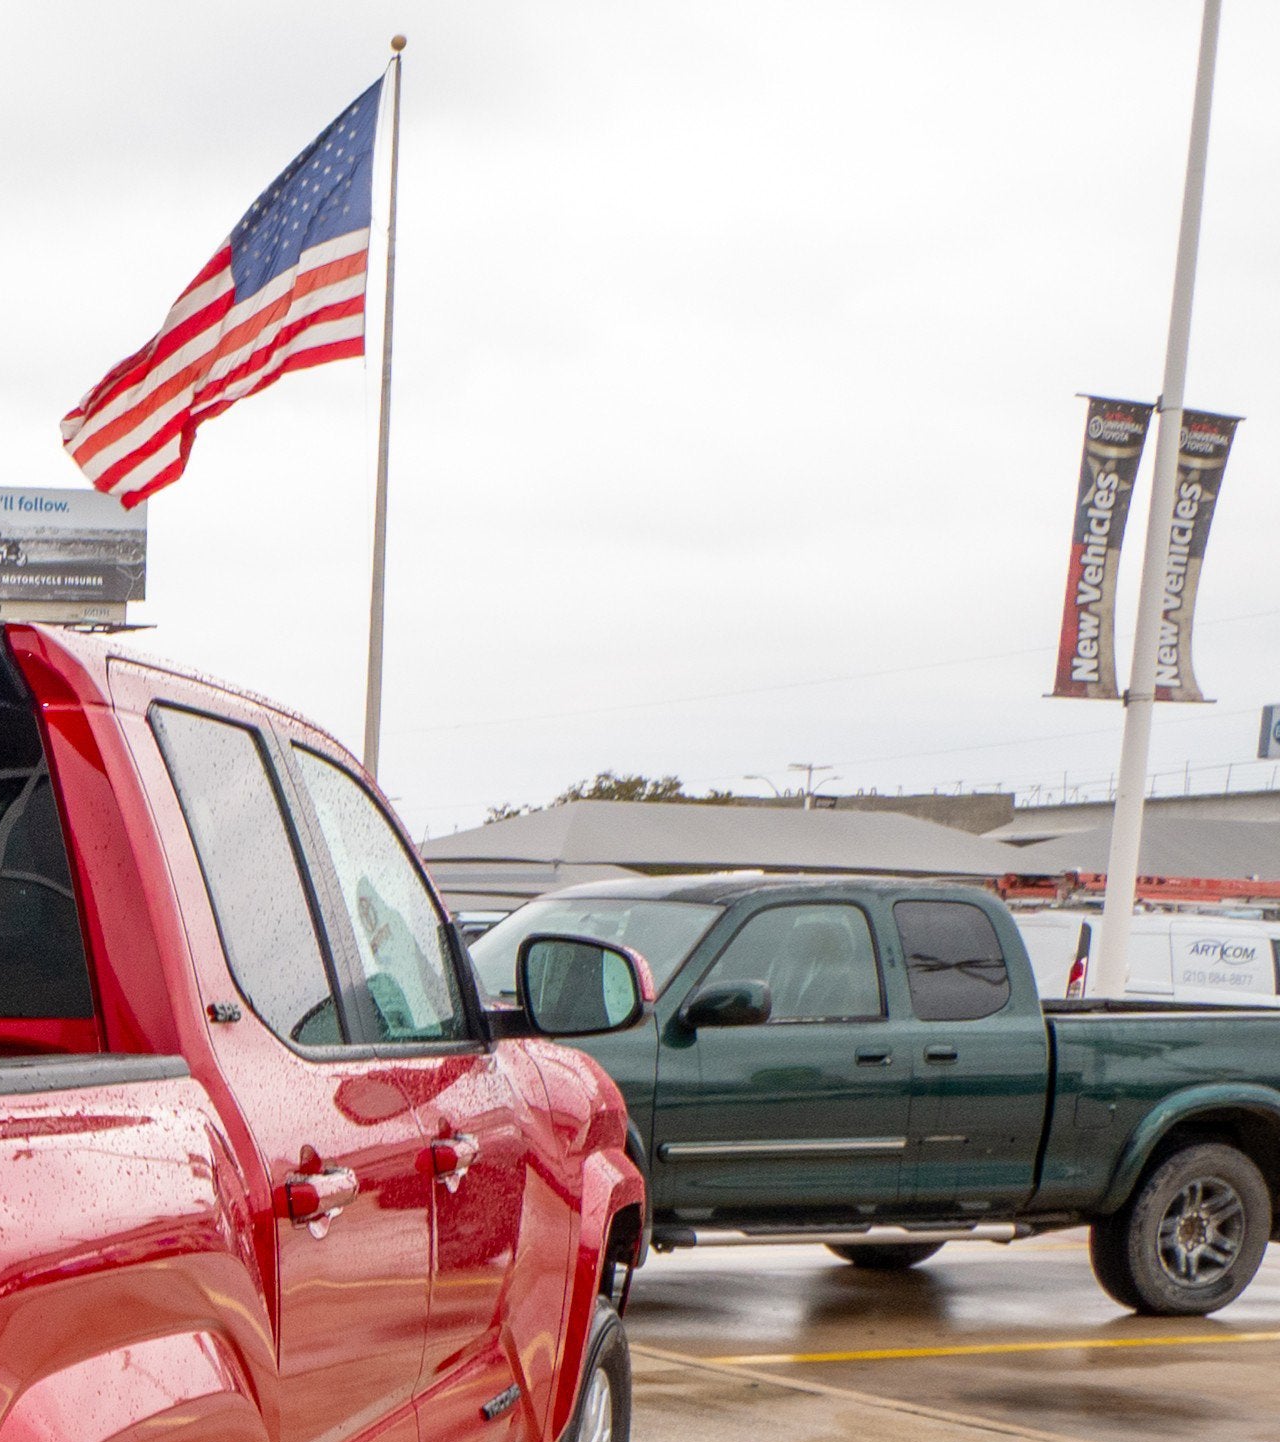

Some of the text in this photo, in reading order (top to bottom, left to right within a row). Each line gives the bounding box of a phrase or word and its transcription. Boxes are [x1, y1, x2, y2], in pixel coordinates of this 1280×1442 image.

[18, 496, 70, 513] follow.
[2, 574, 62, 586] MOTORCYCLE
[64, 576, 104, 587] INSURER
[1072, 471, 1120, 682] New Vehicles
[1155, 620, 1182, 687] New
